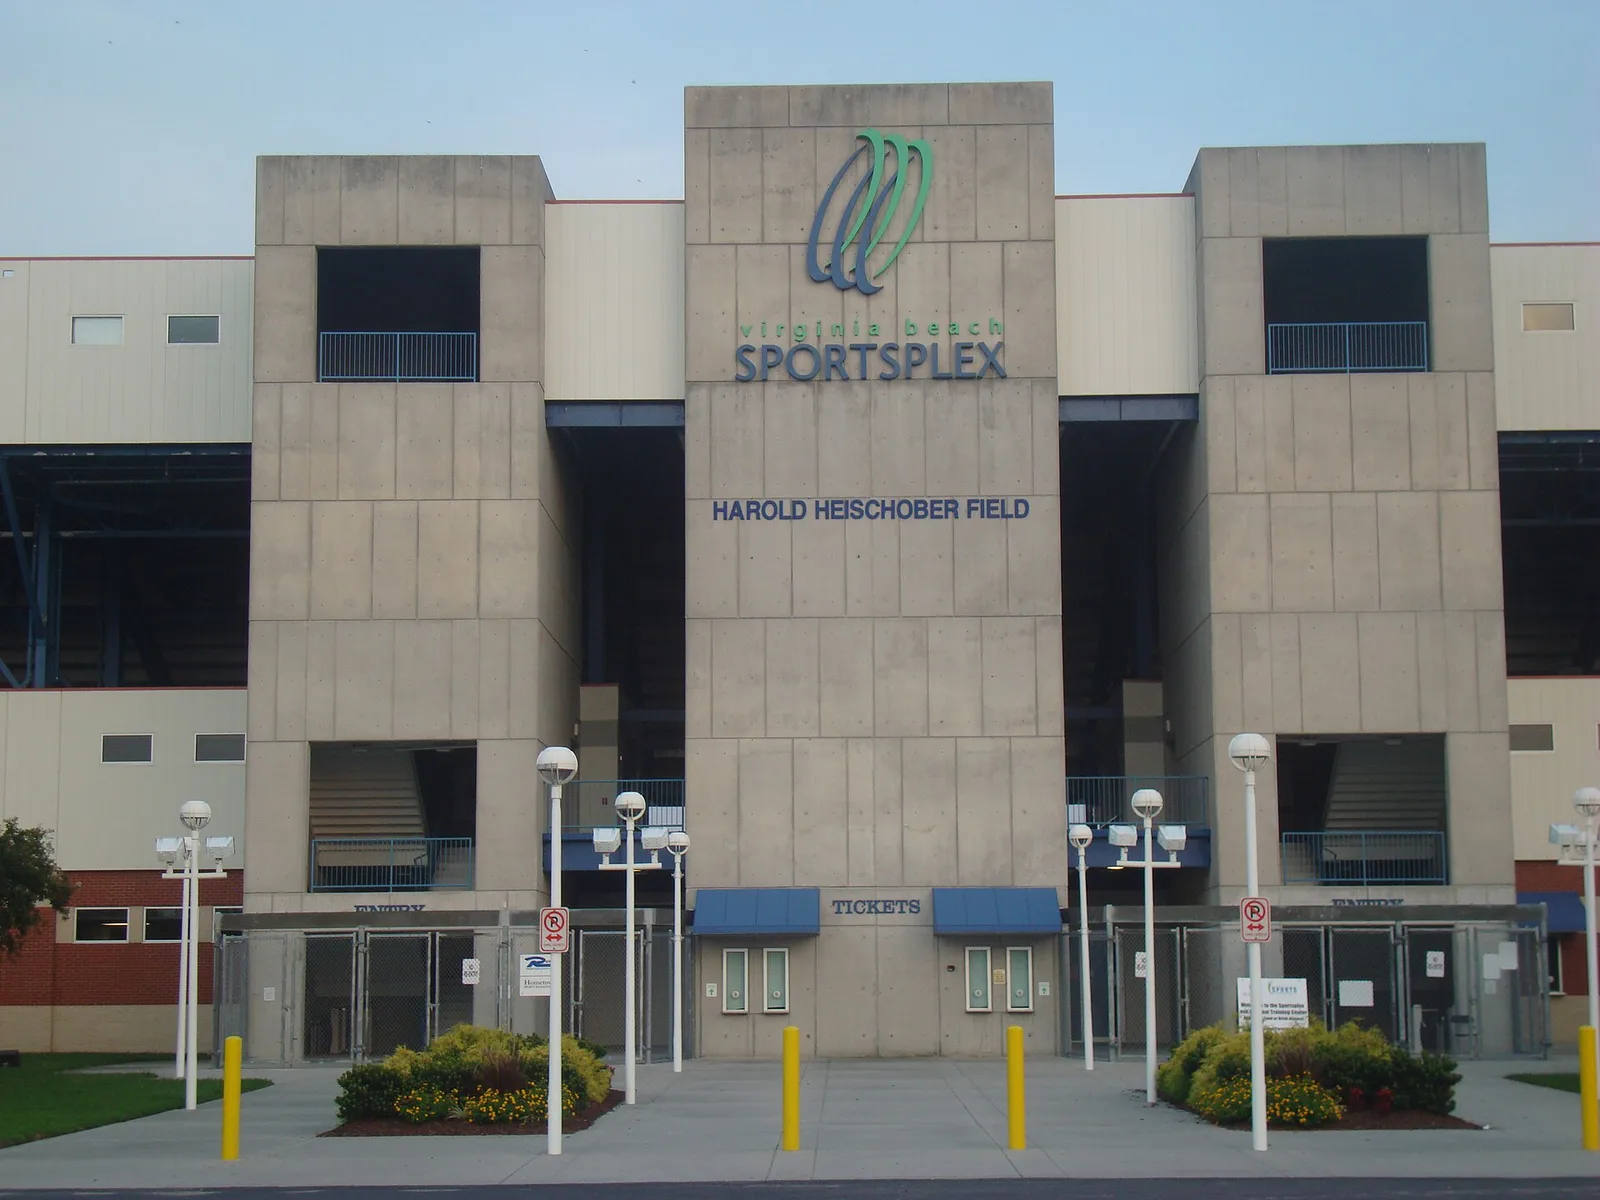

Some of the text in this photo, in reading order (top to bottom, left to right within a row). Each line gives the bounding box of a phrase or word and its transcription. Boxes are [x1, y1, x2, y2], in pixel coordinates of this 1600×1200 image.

[740, 317, 1003, 341] virginia beach
[735, 341, 1008, 381] SPORTSPLEX
[713, 498, 1030, 521] HAROLD HEISCHOBER FIELD
[832, 899, 921, 915] TICKETS
